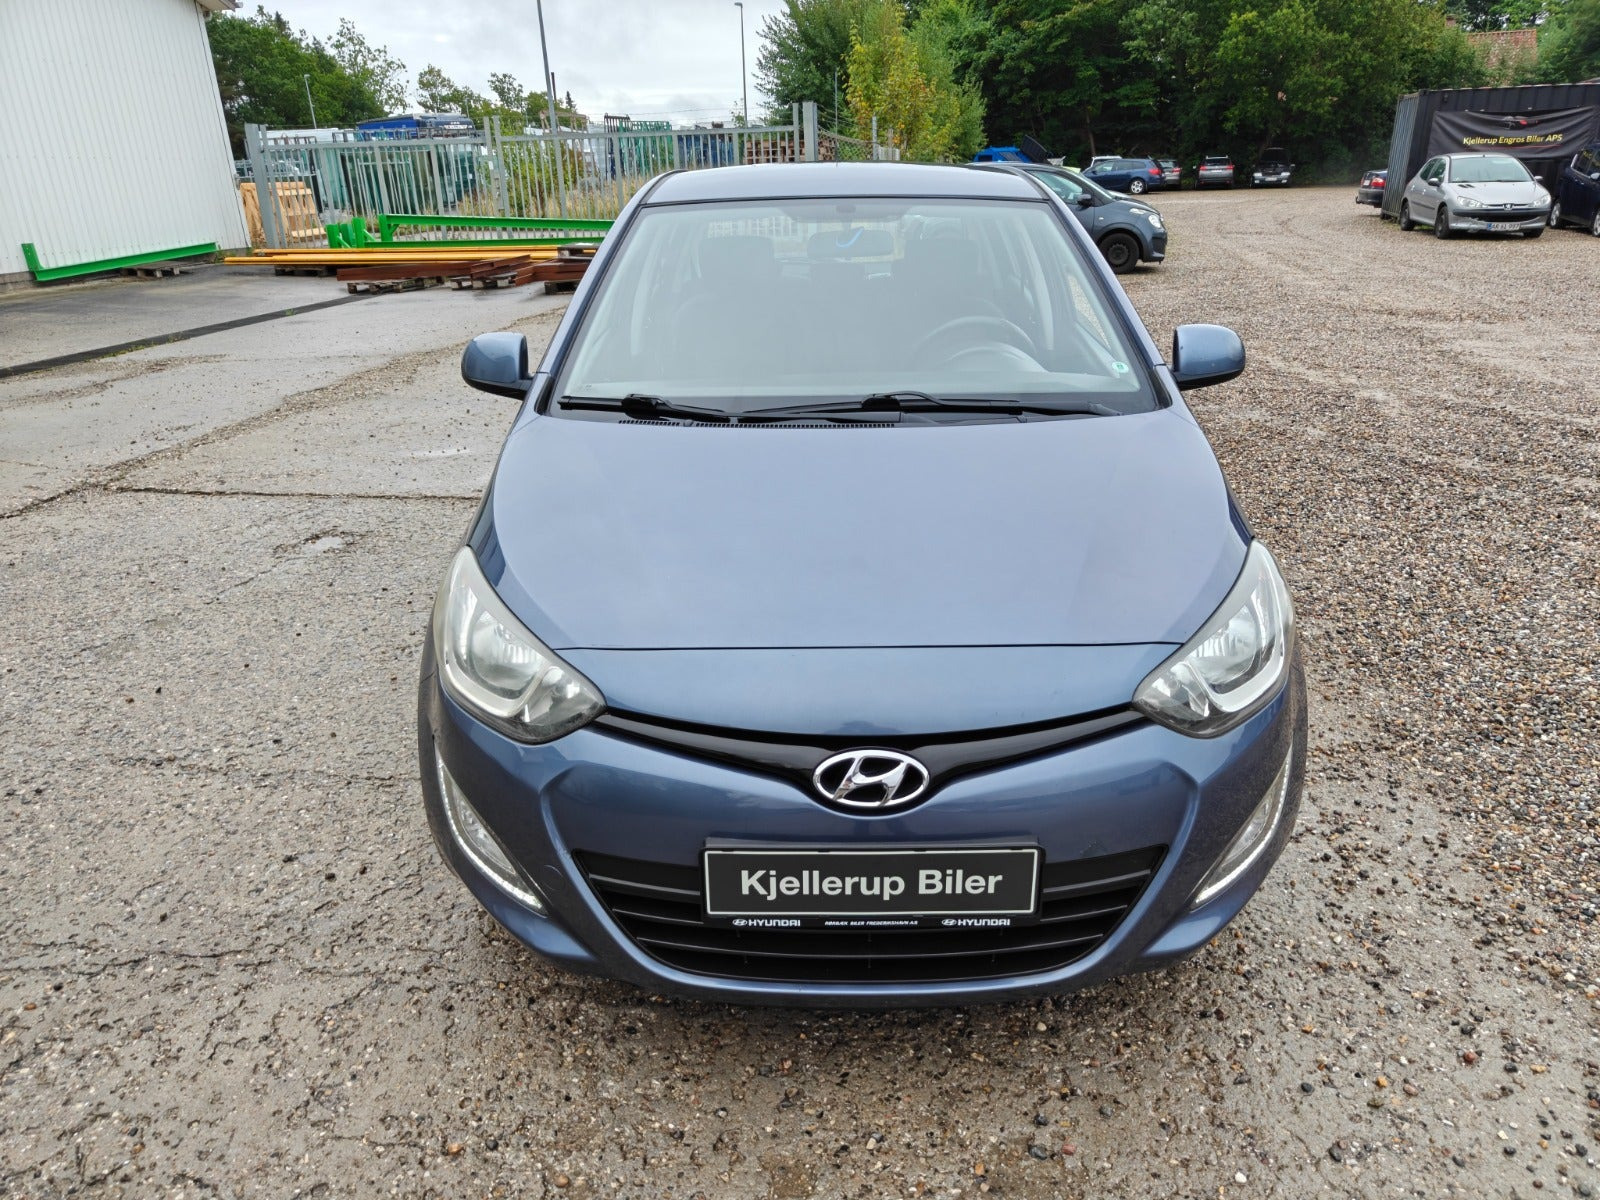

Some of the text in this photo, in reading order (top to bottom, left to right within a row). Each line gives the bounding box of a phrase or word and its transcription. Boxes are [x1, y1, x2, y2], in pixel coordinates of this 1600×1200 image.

[1463, 136, 1498, 146] Kjellerup
[1499, 136, 1525, 145] Engros
[740, 869, 1003, 901] Kjellerup Biler
[748, 918, 801, 927] HYUNDAI
[957, 918, 1010, 926] HYUNDAI
